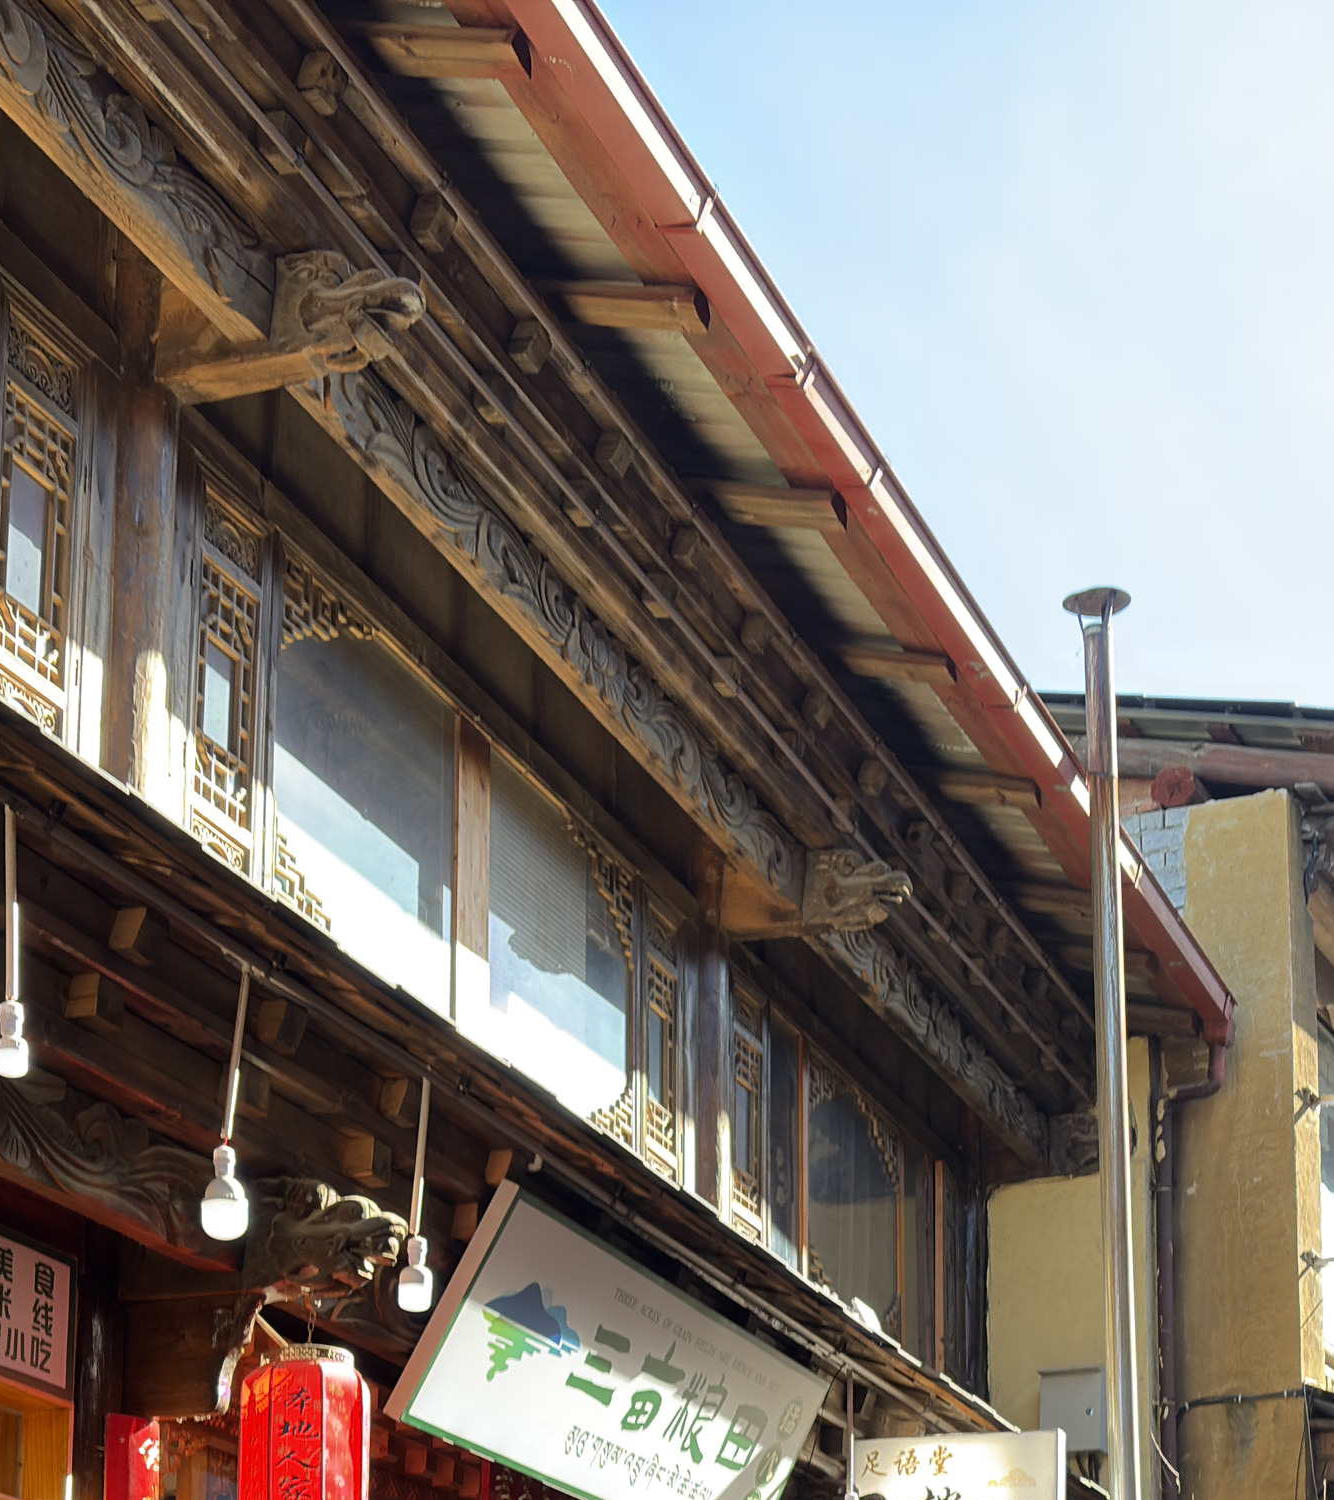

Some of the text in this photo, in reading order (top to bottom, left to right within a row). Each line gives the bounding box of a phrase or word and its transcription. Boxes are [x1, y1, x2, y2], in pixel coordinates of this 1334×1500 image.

[614, 1287, 638, 1312] THREE
[641, 1303, 662, 1324] ACRES
[565, 1324, 769, 1471] 三亩粮田
